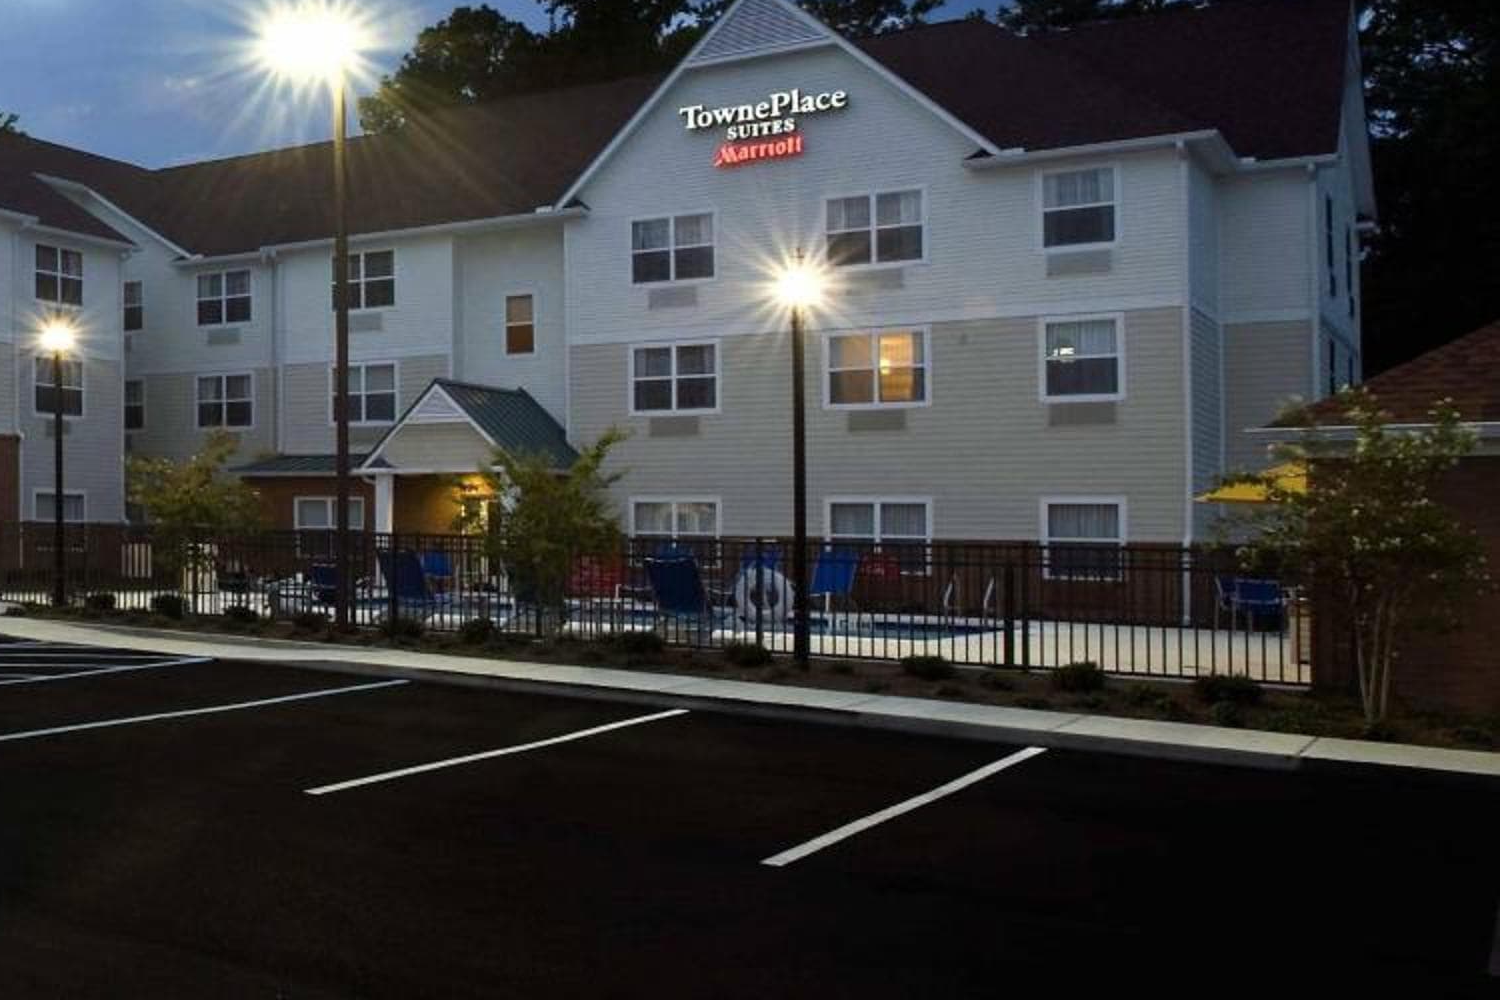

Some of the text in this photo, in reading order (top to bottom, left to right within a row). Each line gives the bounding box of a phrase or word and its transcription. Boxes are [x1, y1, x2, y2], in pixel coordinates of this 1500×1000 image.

[679, 88, 846, 129] TownePlace
[727, 118, 795, 140] SUITES
[715, 135, 802, 166] Marriott
